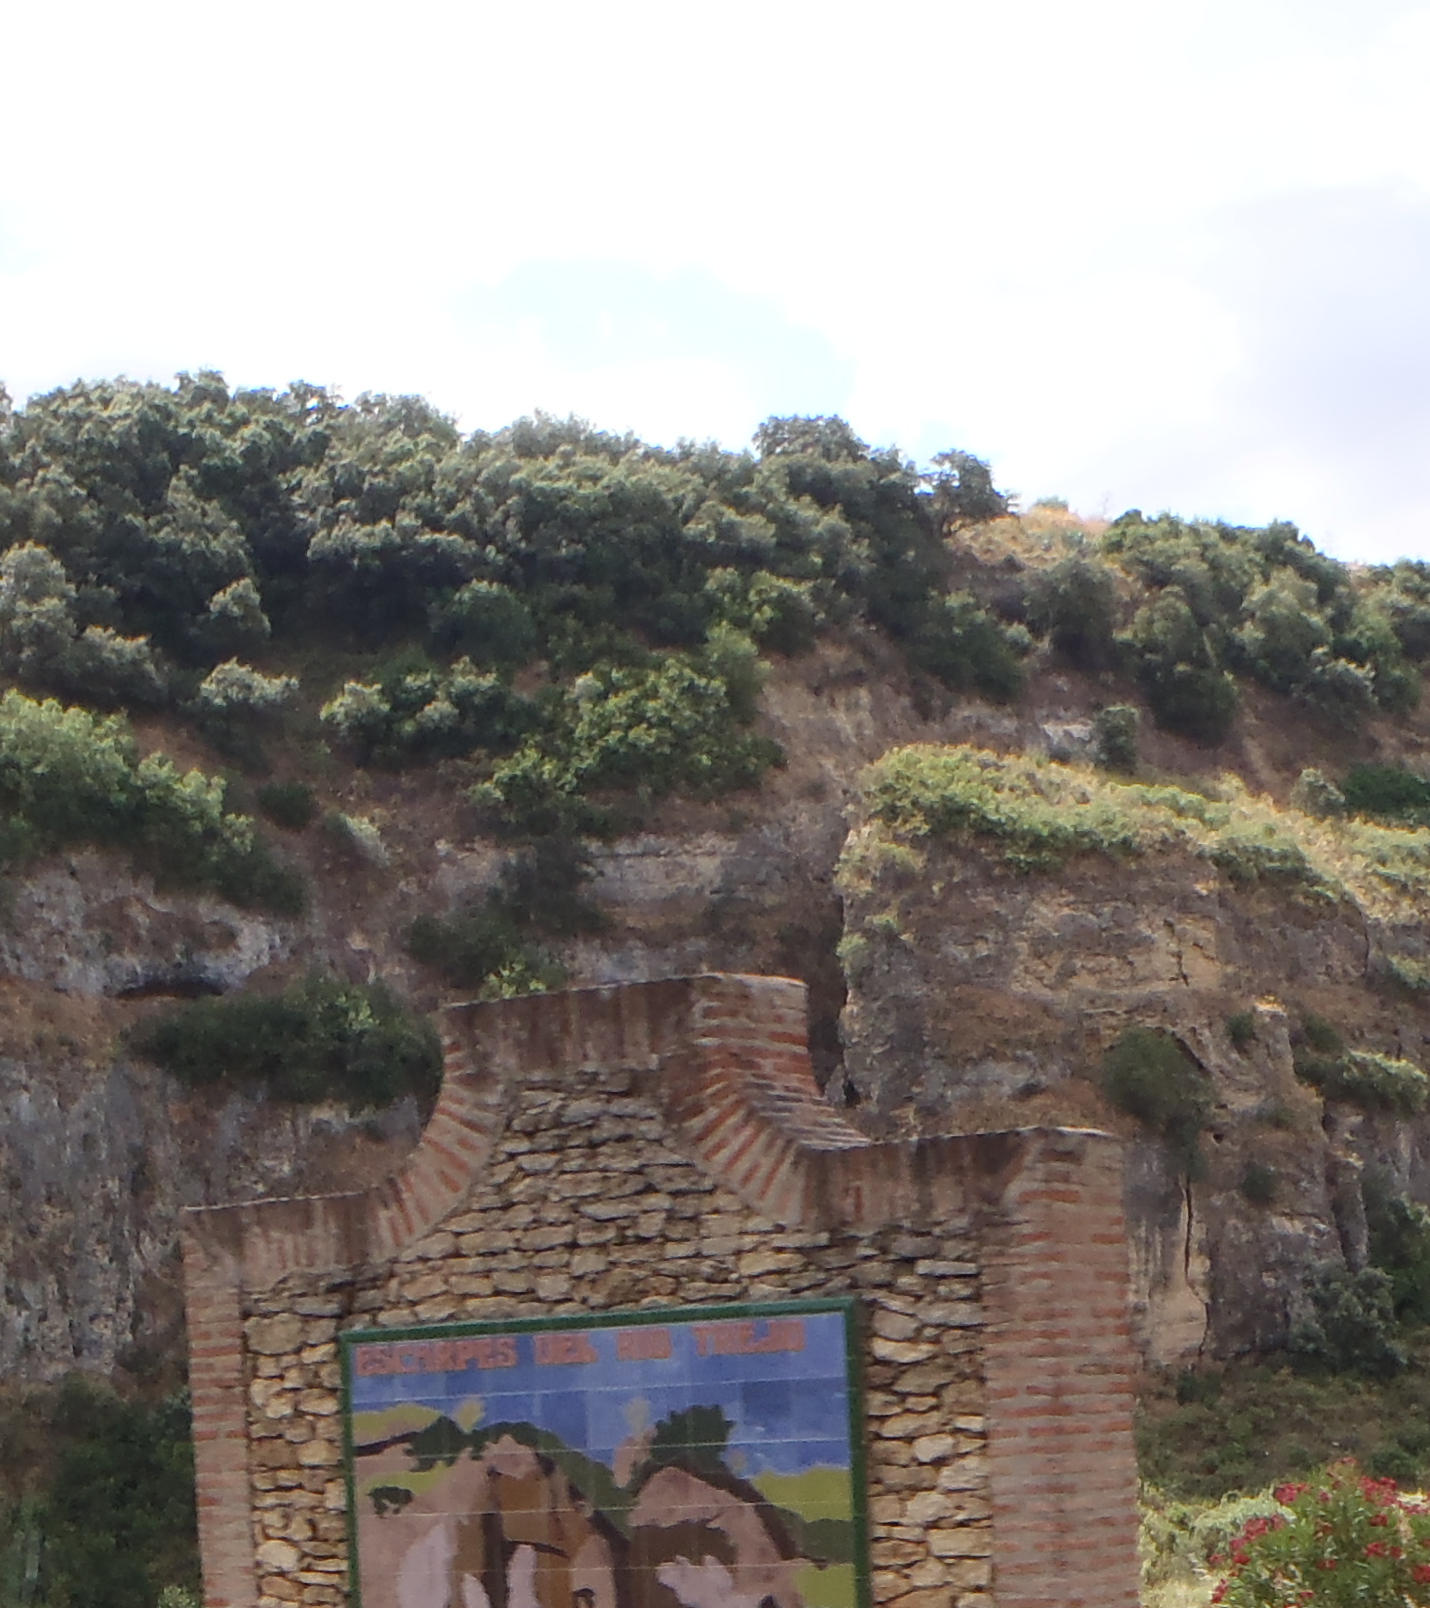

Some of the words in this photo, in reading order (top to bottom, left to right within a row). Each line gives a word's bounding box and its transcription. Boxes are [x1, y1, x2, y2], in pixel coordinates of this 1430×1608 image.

[355, 1337, 517, 1376] ESCARPES
[532, 1333, 599, 1365] DEL
[692, 1319, 806, 1357] TREJO
